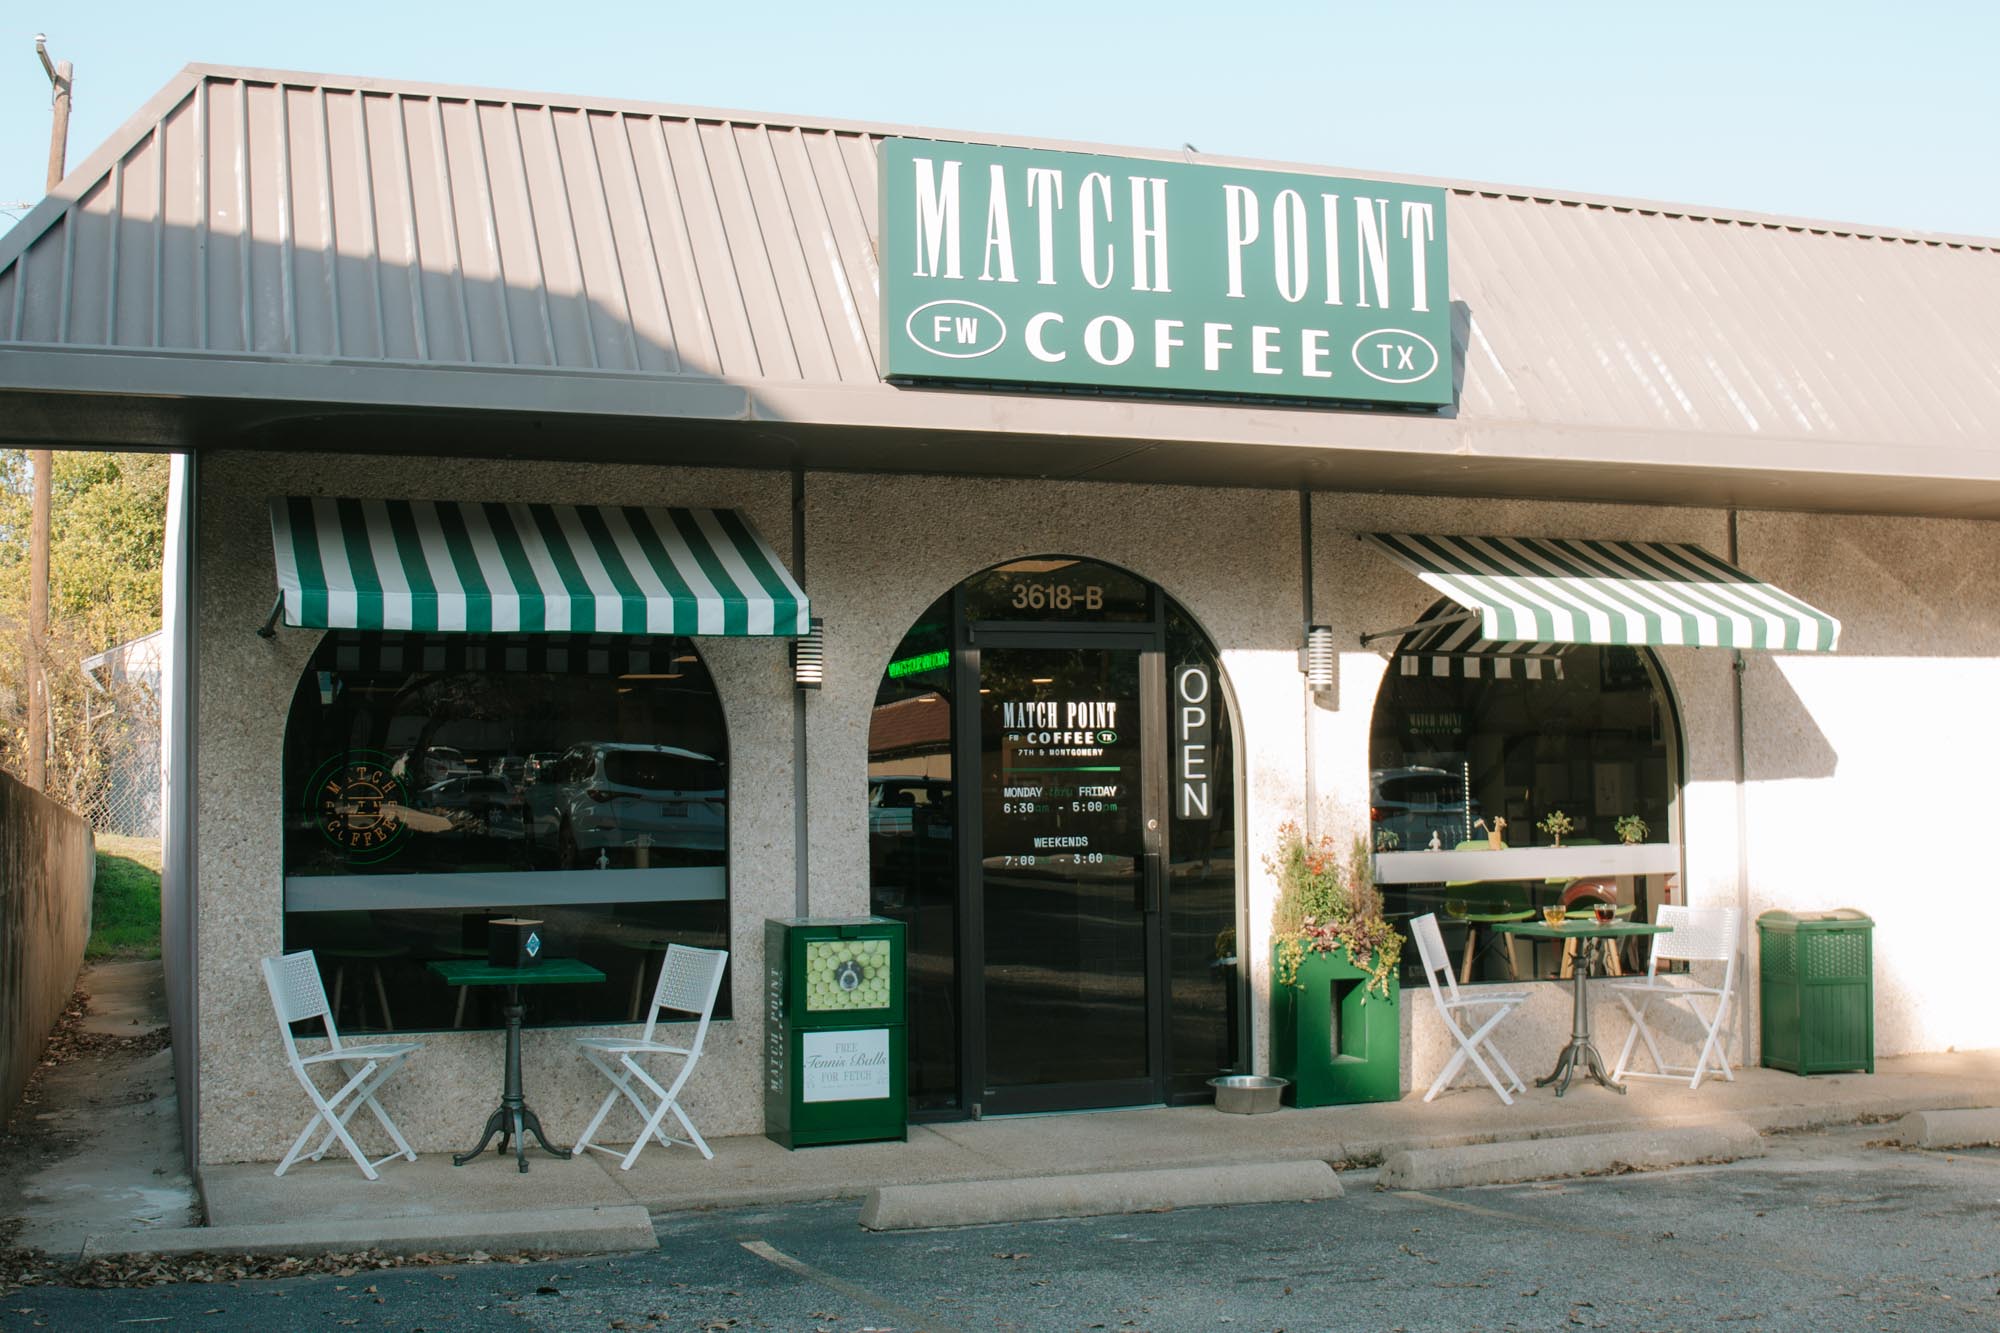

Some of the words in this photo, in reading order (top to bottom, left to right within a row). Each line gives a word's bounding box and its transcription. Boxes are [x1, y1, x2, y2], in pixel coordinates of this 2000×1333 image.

[912, 158, 1172, 293] MATCH
[1222, 184, 1435, 312] POINT
[933, 315, 979, 344] FW
[1024, 311, 1333, 378] COFFEE
[1376, 343, 1415, 371] TX
[1011, 583, 1104, 611] 3618-B
[1003, 701, 1058, 729] MATCH
[1066, 701, 1117, 729] POINT
[1026, 731, 1095, 744] COFFEE
[1101, 733, 1113, 742] TX
[1179, 668, 1209, 818] OPEN
[1049, 748, 1104, 757] MONTGOMERY
[1003, 786, 1043, 798] MONDAY
[1079, 786, 1118, 797] FRIDAY
[1072, 801, 1118, 813] 5:00pm
[1034, 836, 1089, 848] WEEKENDS
[835, 1042, 858, 1054] FREE
[803, 1054, 846, 1069] Tennis
[849, 1050, 887, 1066] Balls
[822, 1071, 839, 1082] FOR
[843, 1071, 873, 1081] FETCH
